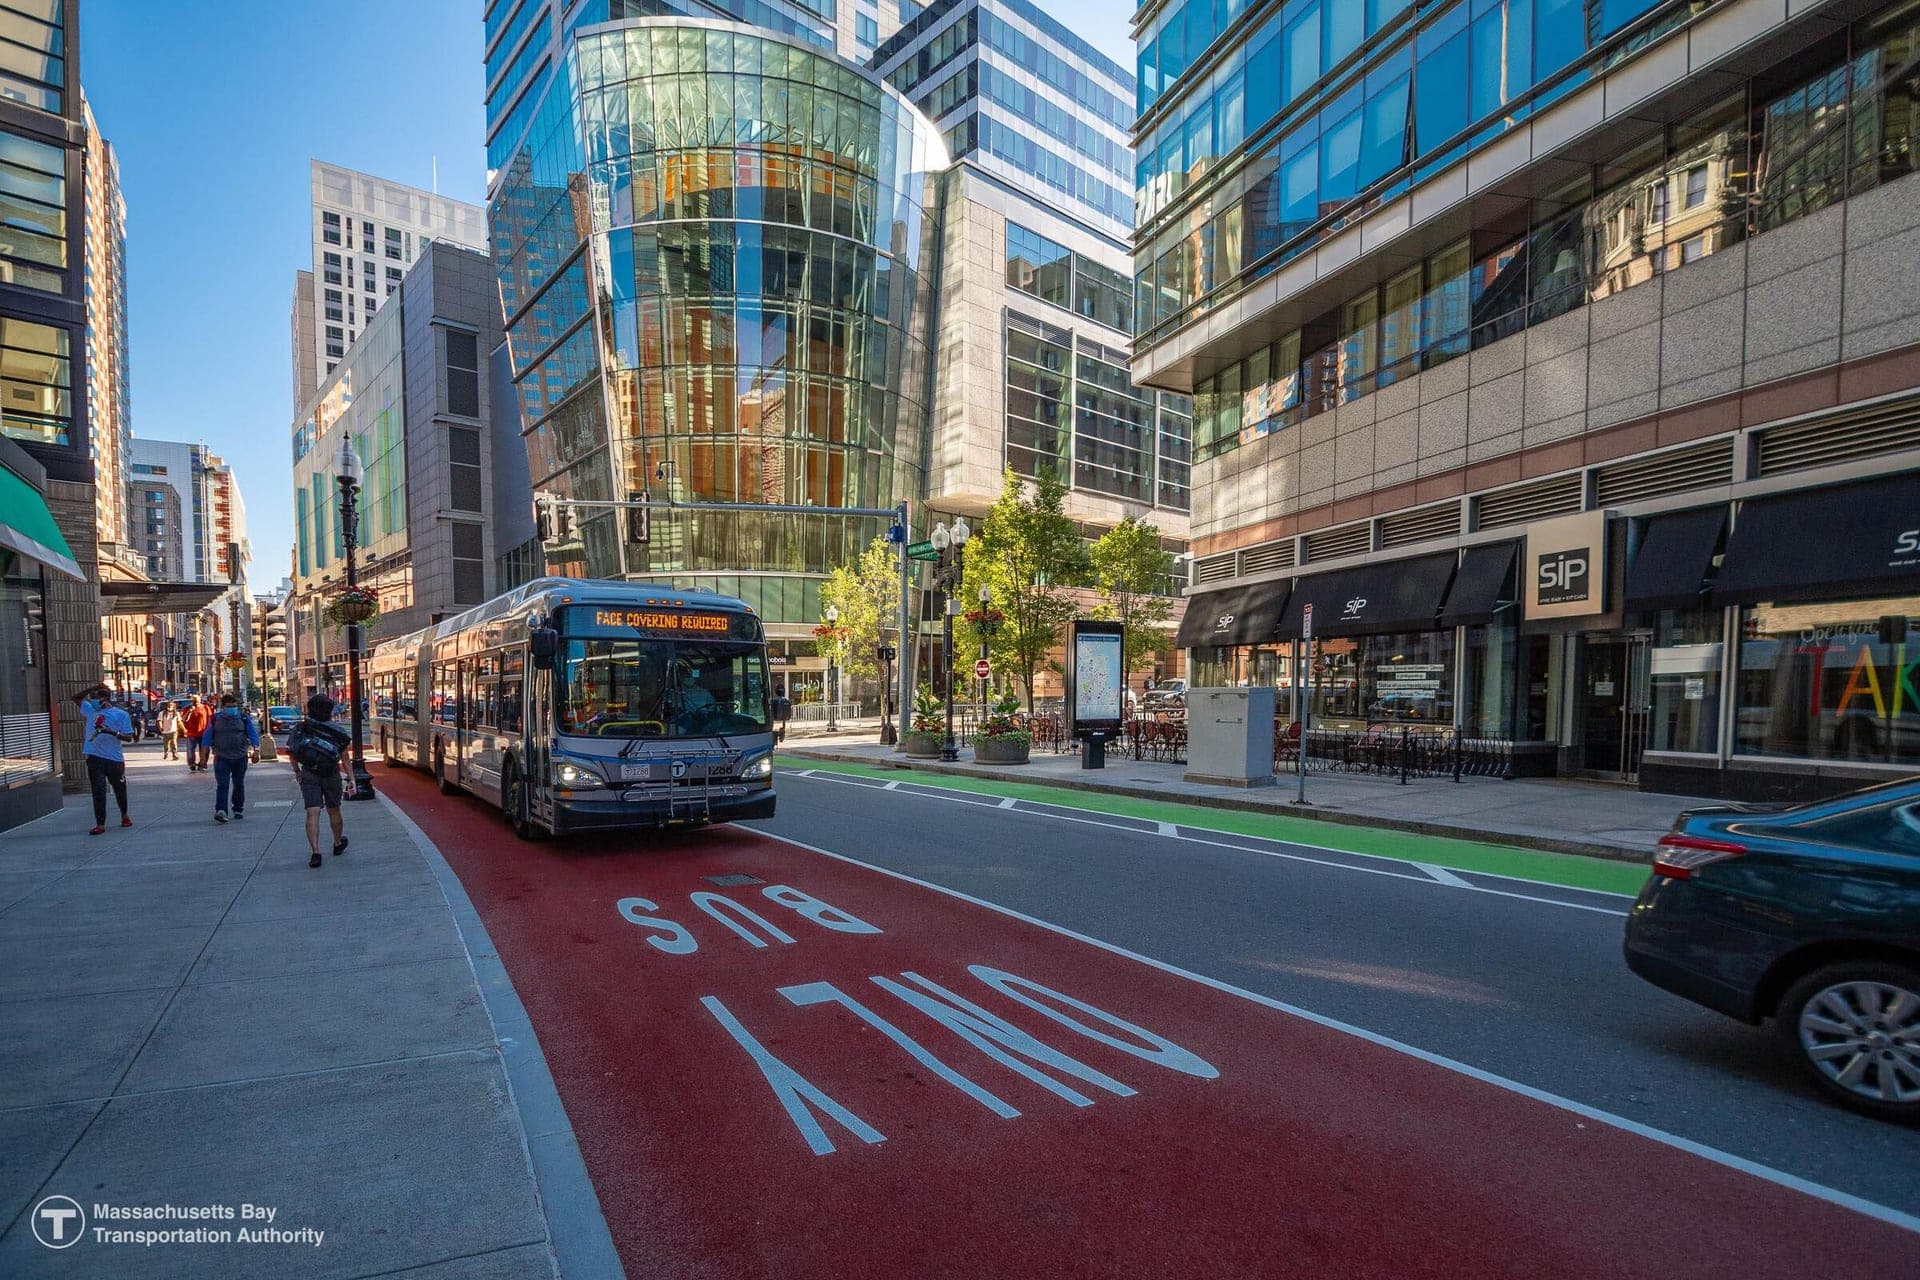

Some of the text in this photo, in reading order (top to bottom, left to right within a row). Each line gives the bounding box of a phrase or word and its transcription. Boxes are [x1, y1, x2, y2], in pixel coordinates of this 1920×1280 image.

[596, 611, 728, 631] FACE COVERING REQUIRED
[632, 768, 649, 776] 1288
[617, 885, 884, 955] BUS
[700, 965, 1220, 1156] ONLY
